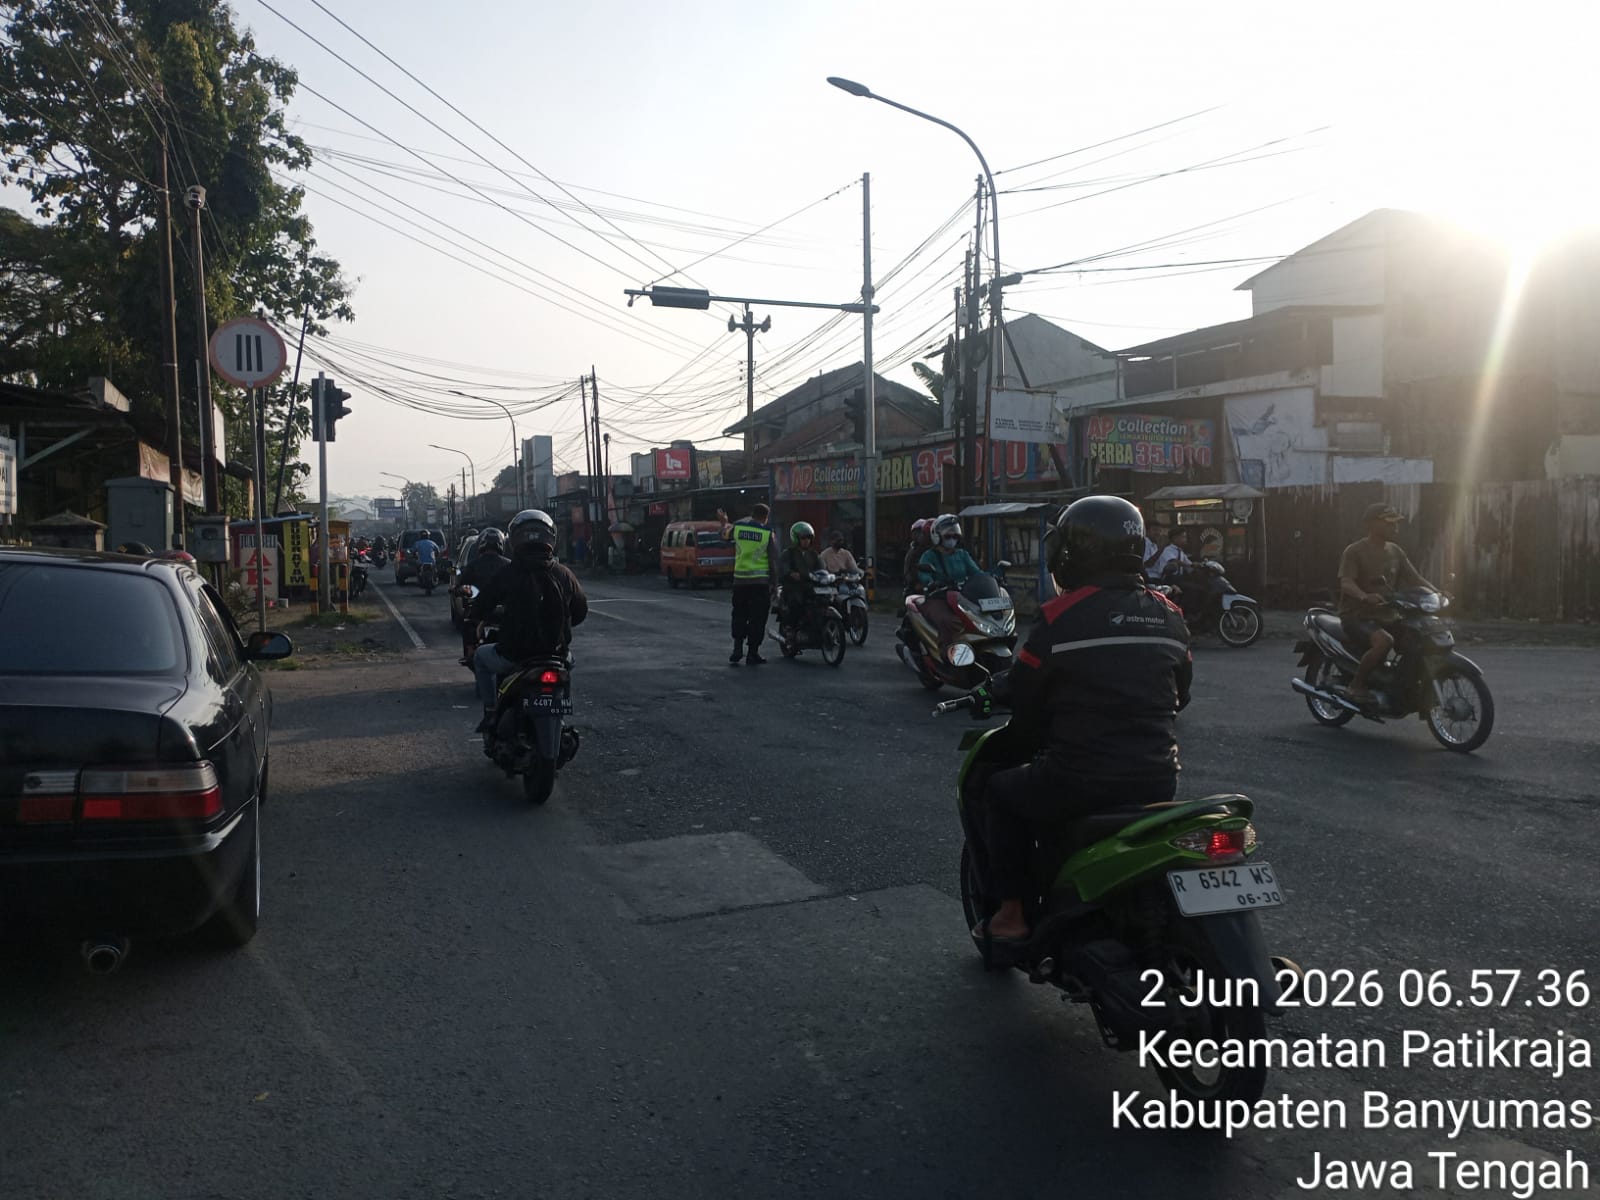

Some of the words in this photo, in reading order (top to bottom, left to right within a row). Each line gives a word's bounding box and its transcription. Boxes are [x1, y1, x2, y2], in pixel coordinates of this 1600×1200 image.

[1087, 415, 1115, 437] AP
[1117, 419, 1188, 435] Collection
[1089, 442, 1134, 465] SERBA
[813, 463, 861, 482] Collection
[862, 455, 916, 492] ERBA
[739, 531, 762, 541] POLISI
[1173, 874, 1187, 892] R
[1198, 869, 1242, 890] 6542
[1249, 866, 1274, 885] WS
